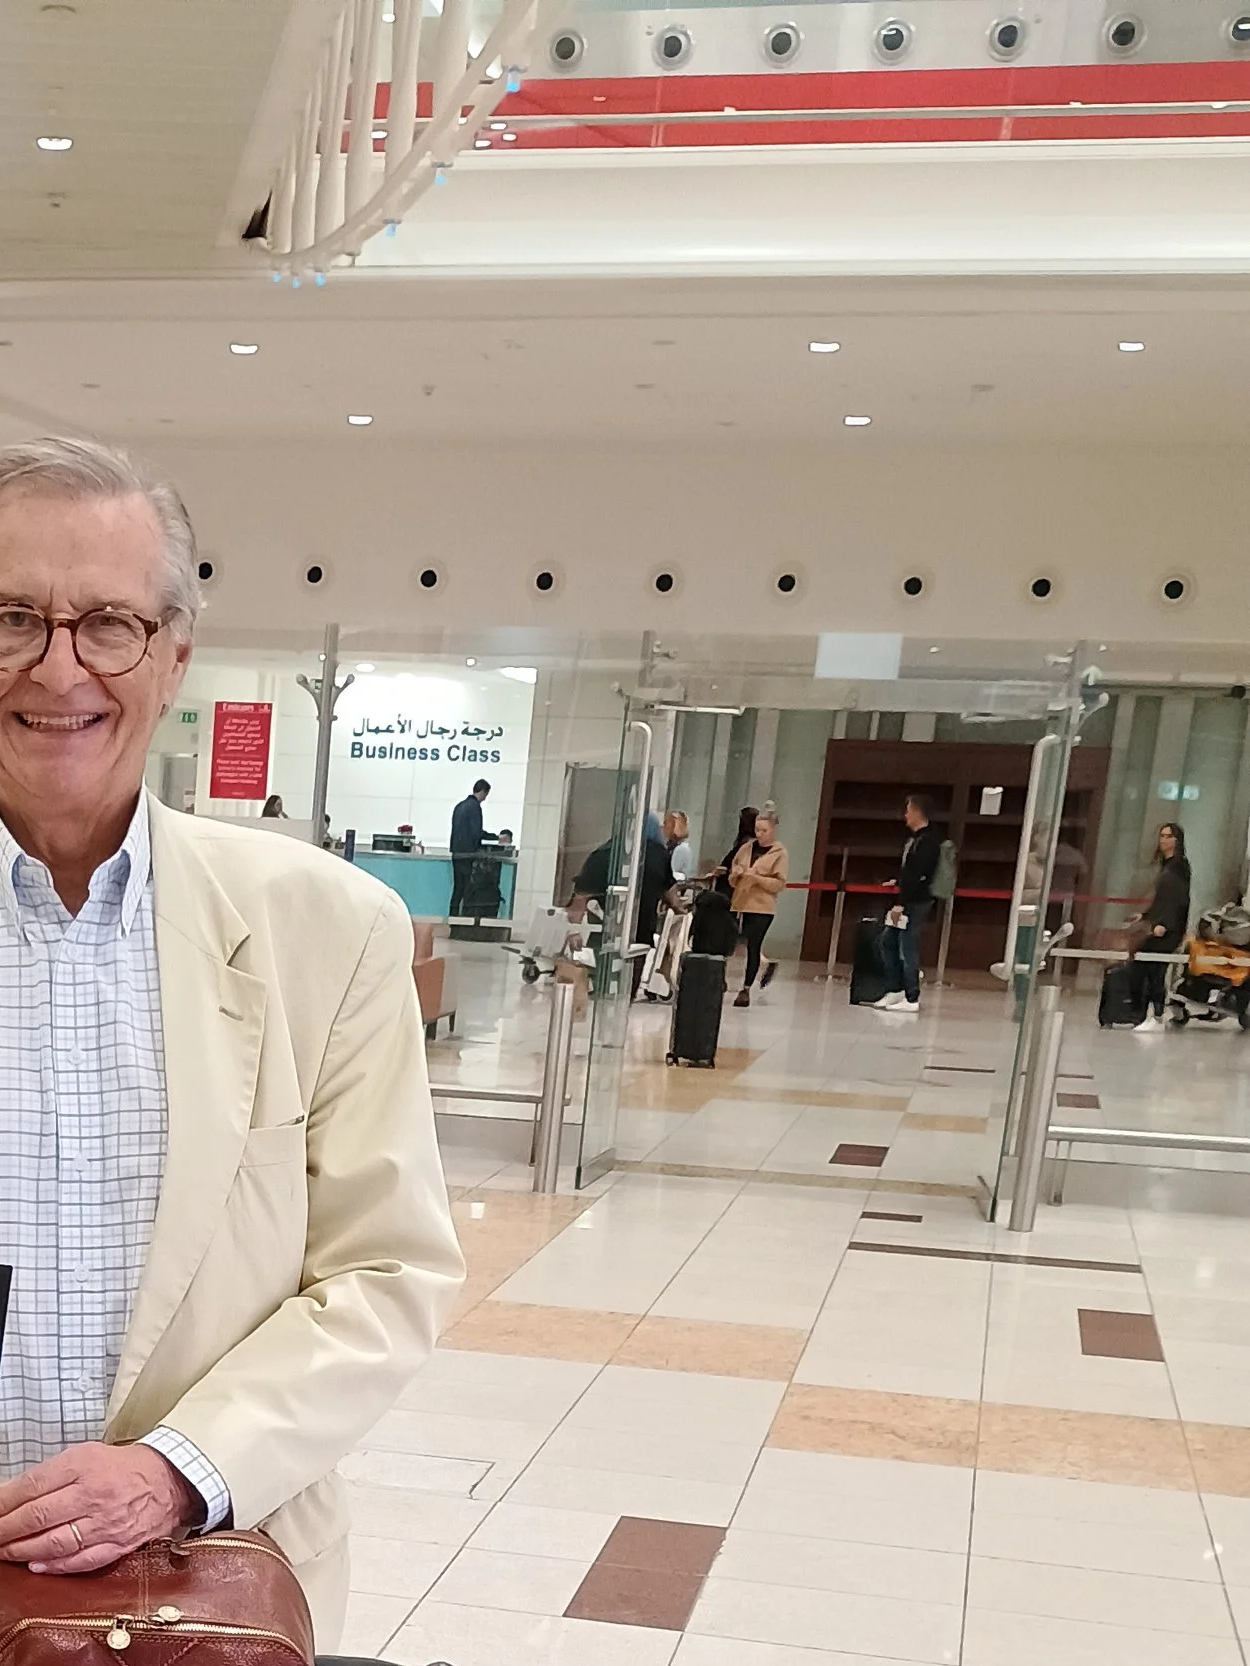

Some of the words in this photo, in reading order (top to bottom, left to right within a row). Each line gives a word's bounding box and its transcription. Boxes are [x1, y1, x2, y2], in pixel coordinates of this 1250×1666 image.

[353, 713, 412, 737] الأعمال
[416, 720, 457, 740] رجال
[461, 721, 504, 741] درجة
[350, 742, 440, 761] Business
[447, 744, 501, 763] Class
